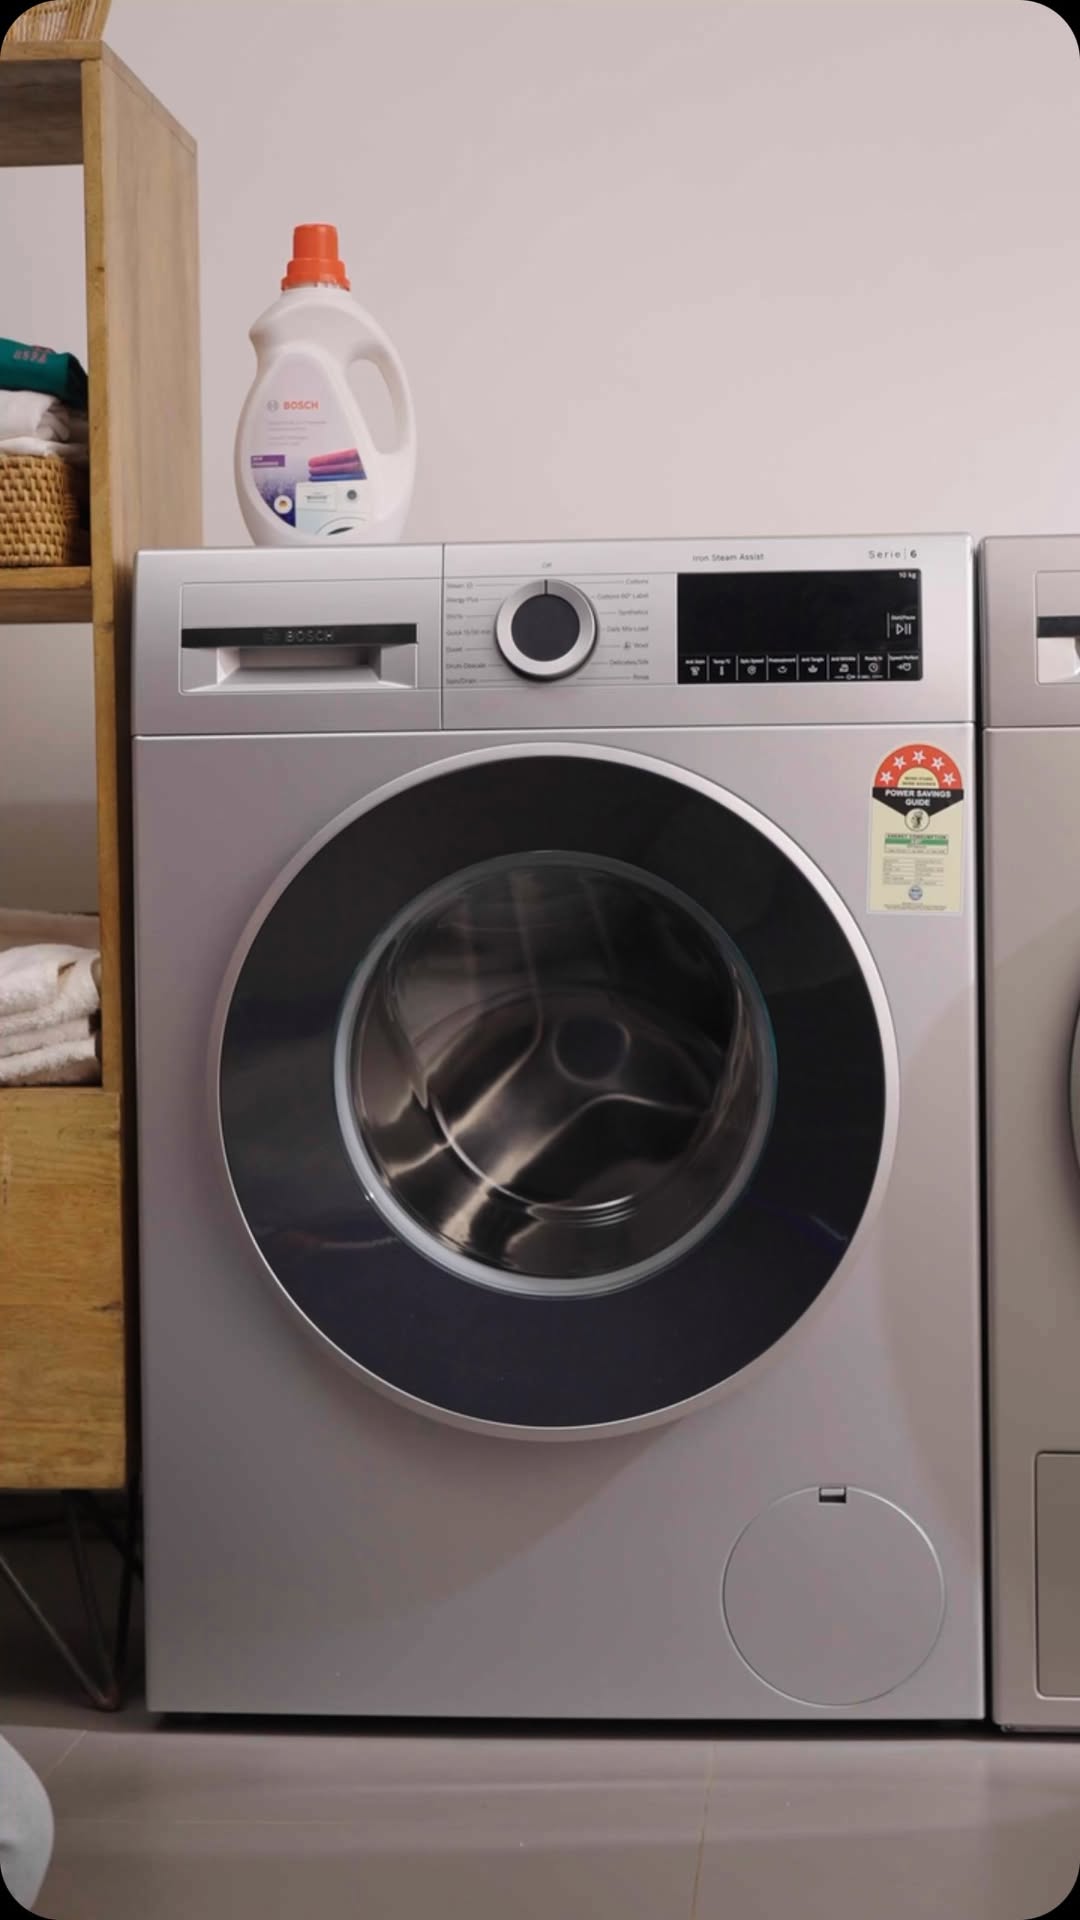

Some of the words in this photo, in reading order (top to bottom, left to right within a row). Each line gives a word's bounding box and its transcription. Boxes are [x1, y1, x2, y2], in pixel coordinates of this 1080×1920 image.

[284, 401, 319, 410] BOSCH
[711, 553, 737, 562] Steam
[740, 553, 765, 561] Assist
[868, 550, 901, 560] Serie
[910, 549, 918, 559] 6
[285, 630, 335, 643] BOSCH
[885, 788, 914, 798] POWER
[916, 790, 952, 799] SAVINGS
[905, 798, 931, 807] GUIDE
